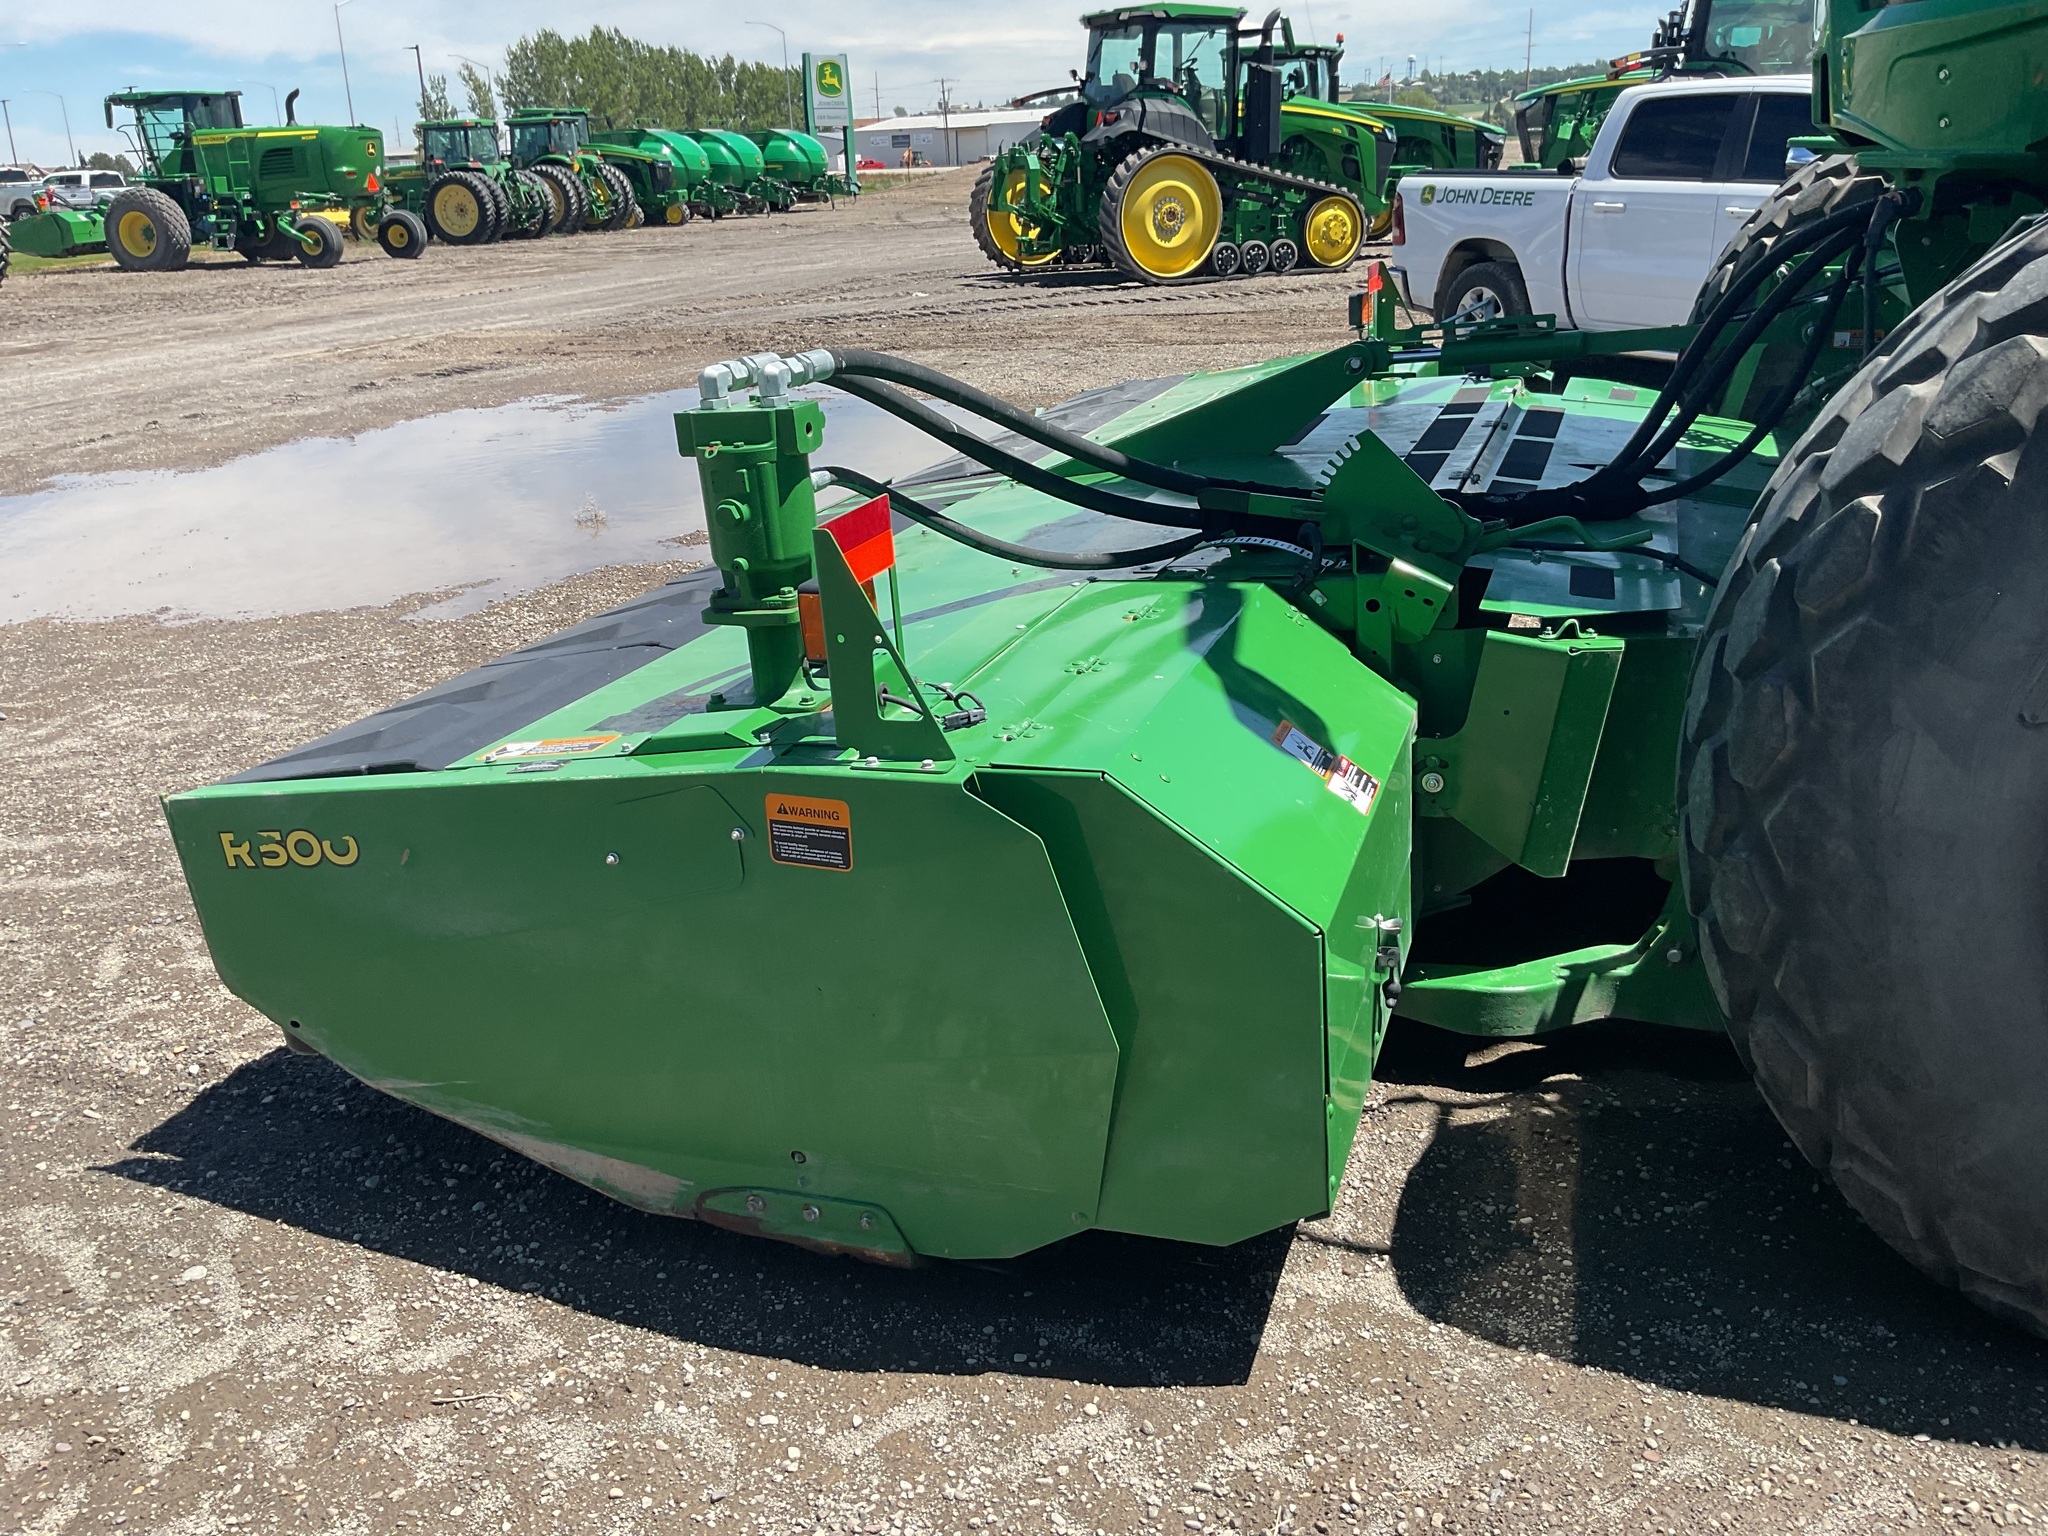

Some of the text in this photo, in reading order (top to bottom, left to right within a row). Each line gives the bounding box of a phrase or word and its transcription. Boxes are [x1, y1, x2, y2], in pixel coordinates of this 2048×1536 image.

[1436, 186, 1535, 206] JOHN DEERE
[788, 806, 840, 820] WARNING
